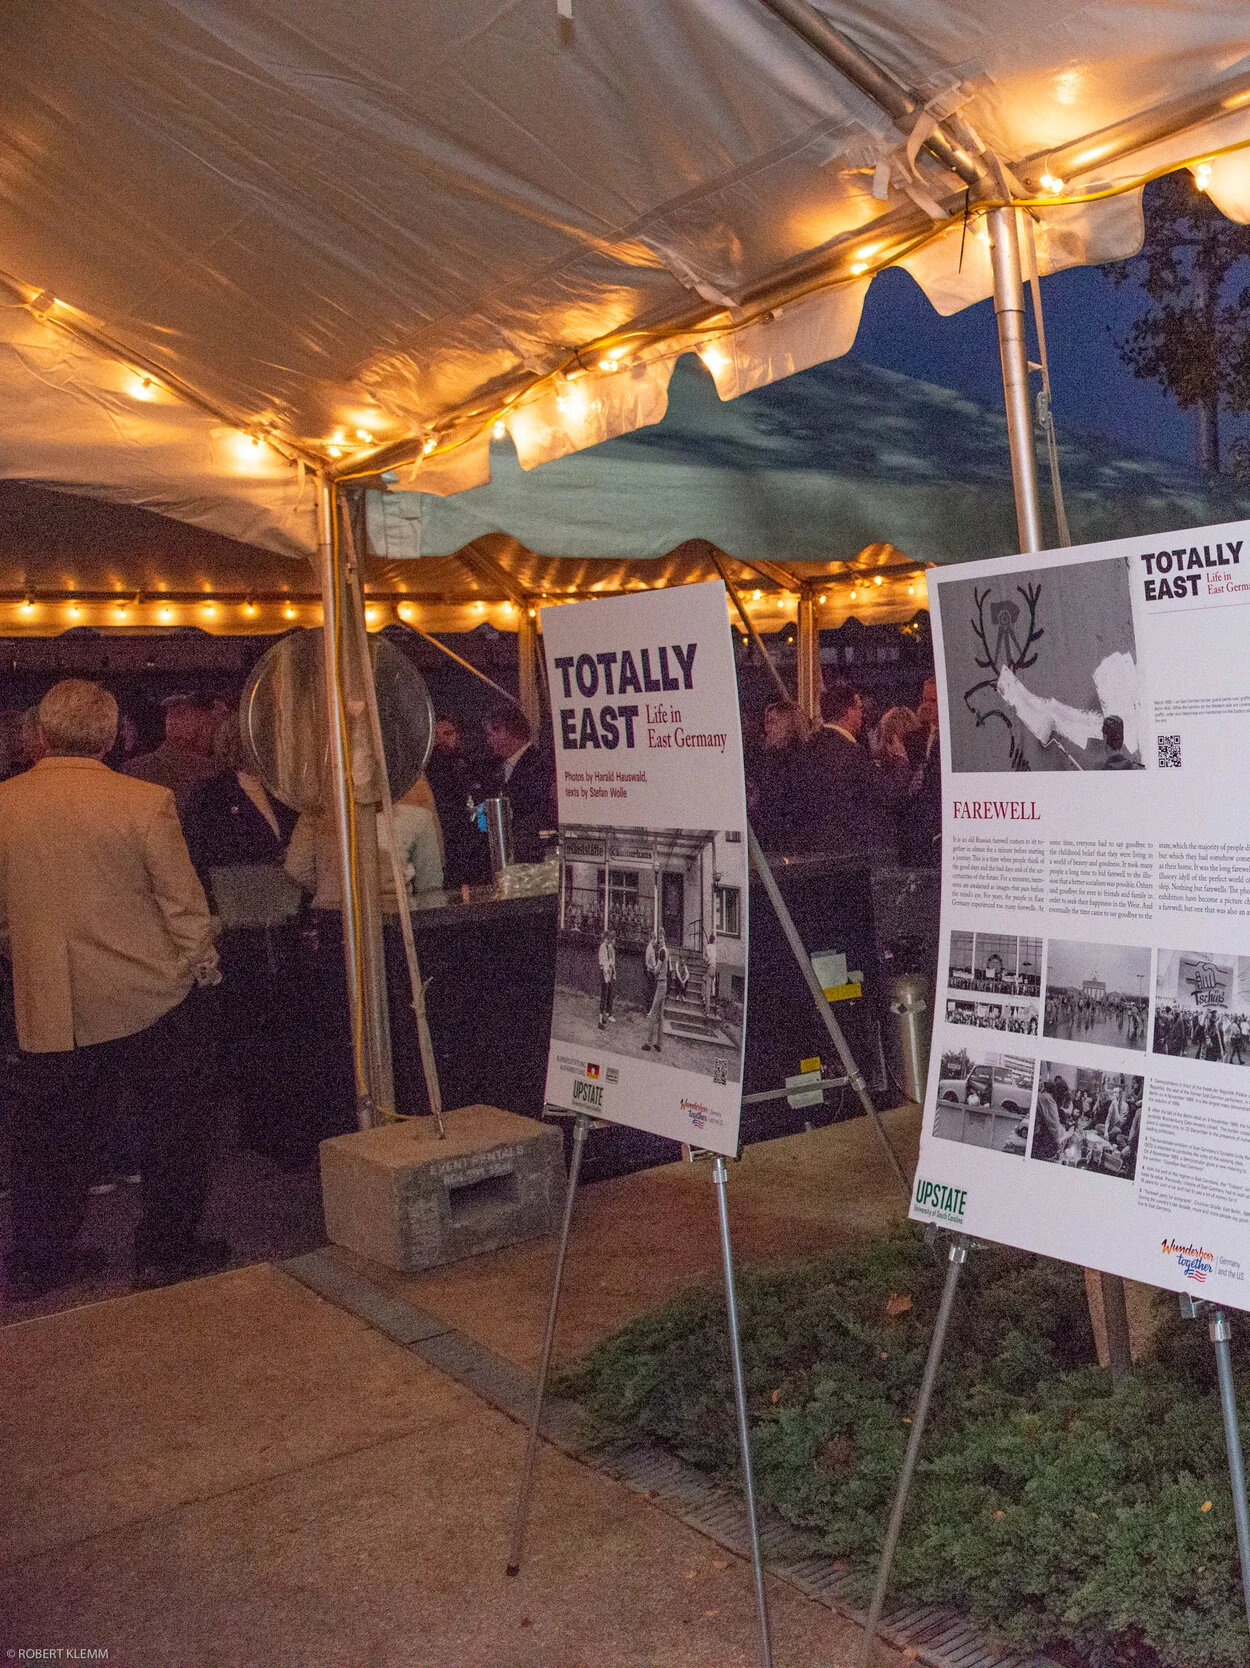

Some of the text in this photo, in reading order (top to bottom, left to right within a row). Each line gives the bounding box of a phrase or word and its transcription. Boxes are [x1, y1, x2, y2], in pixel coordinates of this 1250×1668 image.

[1141, 541, 1244, 575] TOTALLY
[1144, 574, 1201, 602] EAST
[1206, 571, 1232, 583] Life in
[1207, 584, 1225, 595] East
[554, 643, 698, 698] TOTALLY
[646, 704, 682, 724] Life in
[560, 705, 639, 750] EAST
[647, 727, 728, 754] East Germany
[564, 771, 647, 784] Photos by Harald Hauswald,
[565, 786, 628, 799] texts by Stefan Wolle
[952, 801, 1041, 820] FAREWELL
[573, 1080, 604, 1106] UPSTATE
[916, 1179, 968, 1215] UPSTATE
[1161, 1238, 1215, 1261] Wunderbar
[1176, 1253, 1213, 1275] together
[1218, 1268, 1228, 1276] and
[1228, 1269, 1237, 1279] the
[1219, 1256, 1240, 1269] Germany
